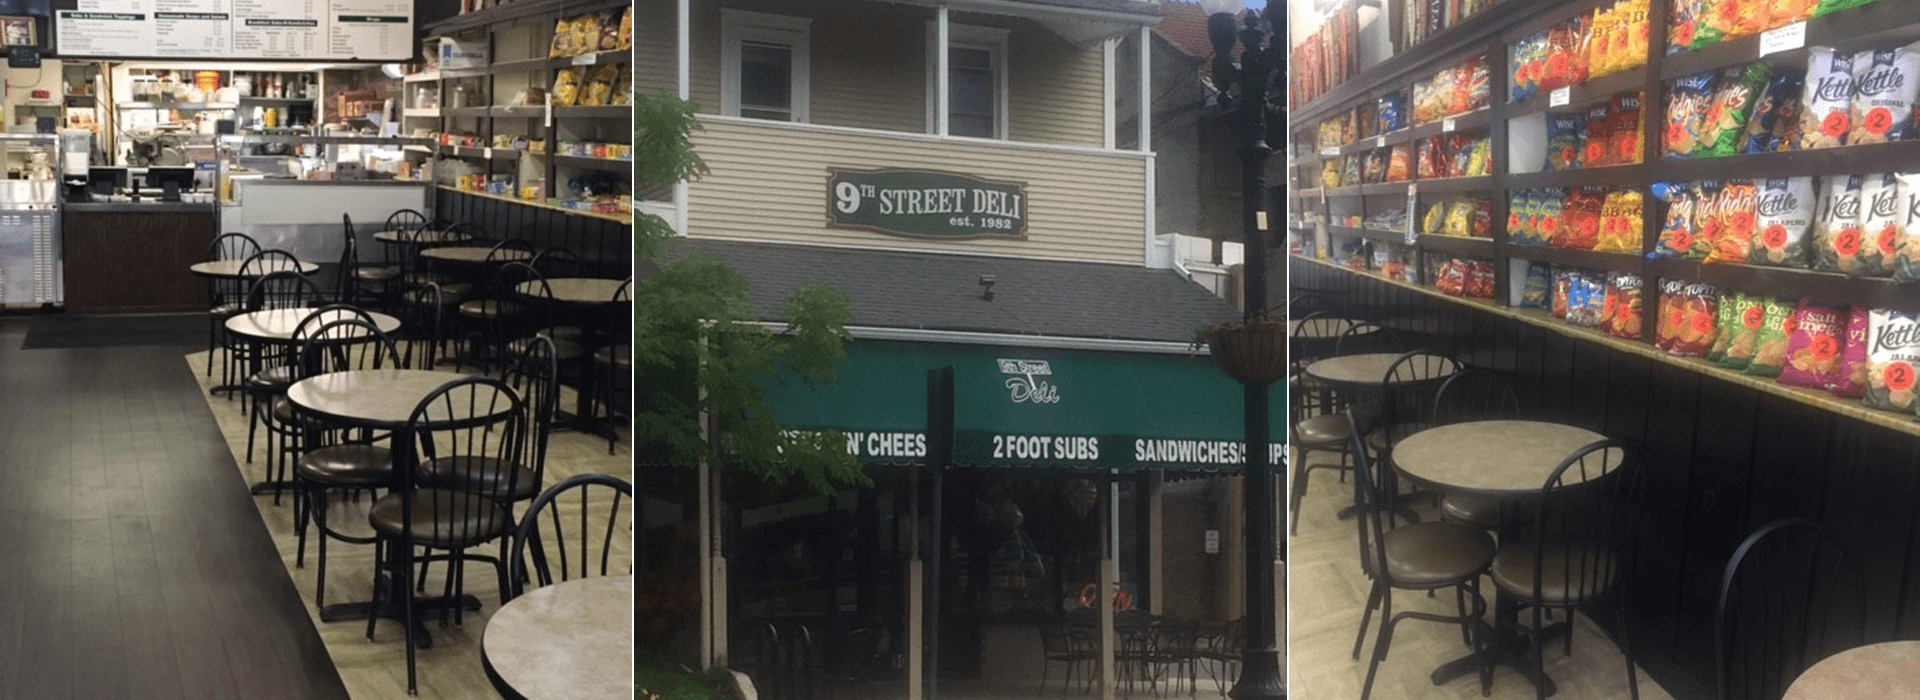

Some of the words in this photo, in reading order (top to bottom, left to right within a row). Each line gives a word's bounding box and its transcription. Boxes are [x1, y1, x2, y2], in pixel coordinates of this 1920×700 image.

[1811, 76, 1856, 105] Kettl
[1855, 67, 1904, 100] Kettle
[1621, 97, 1639, 107] WIS
[879, 188, 967, 215] STREET
[972, 188, 1021, 220] DELI
[949, 217, 975, 228] est.
[980, 217, 1012, 229] 1982
[1893, 367, 1906, 383] 2
[1005, 377, 1060, 404] Deli
[867, 432, 927, 457] CHEES
[993, 435, 1004, 459] 2
[1006, 436, 1051, 460] FOOT
[1054, 437, 1099, 461] SUBS
